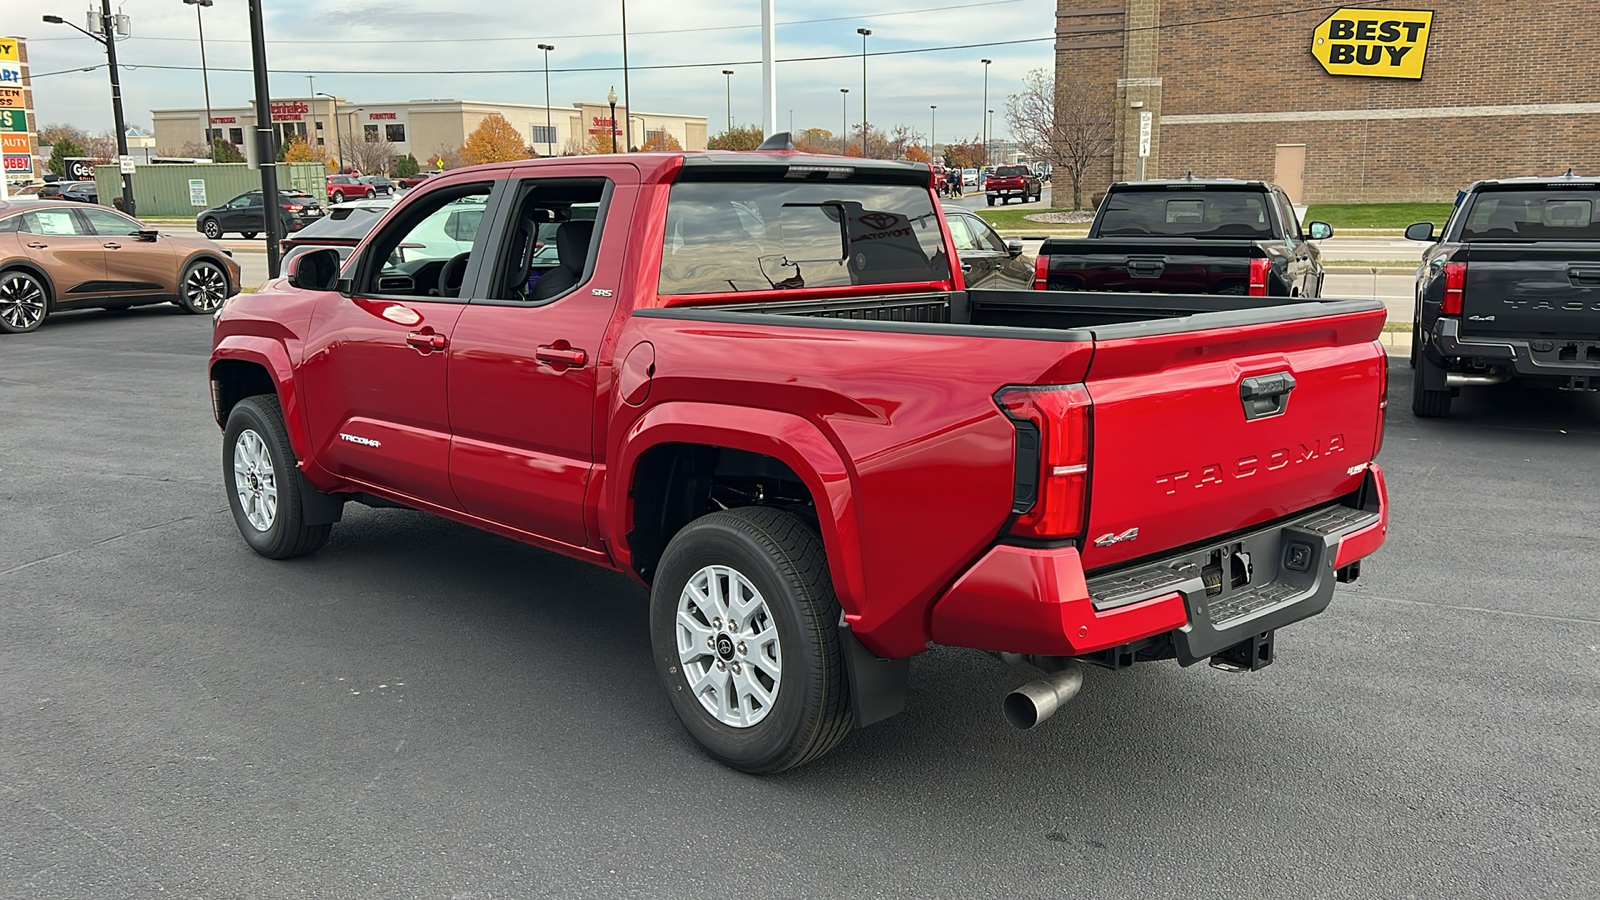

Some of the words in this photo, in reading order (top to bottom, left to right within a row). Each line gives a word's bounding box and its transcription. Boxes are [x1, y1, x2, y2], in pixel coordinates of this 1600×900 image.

[1328, 20, 1426, 43] BEST
[0, 45, 13, 54] Y
[1329, 44, 1413, 66] BUY
[2, 138, 27, 147] AUTY
[340, 433, 381, 448] TACOMA
[1155, 433, 1345, 494] TACOMA
[1093, 527, 1139, 546] 4x4
